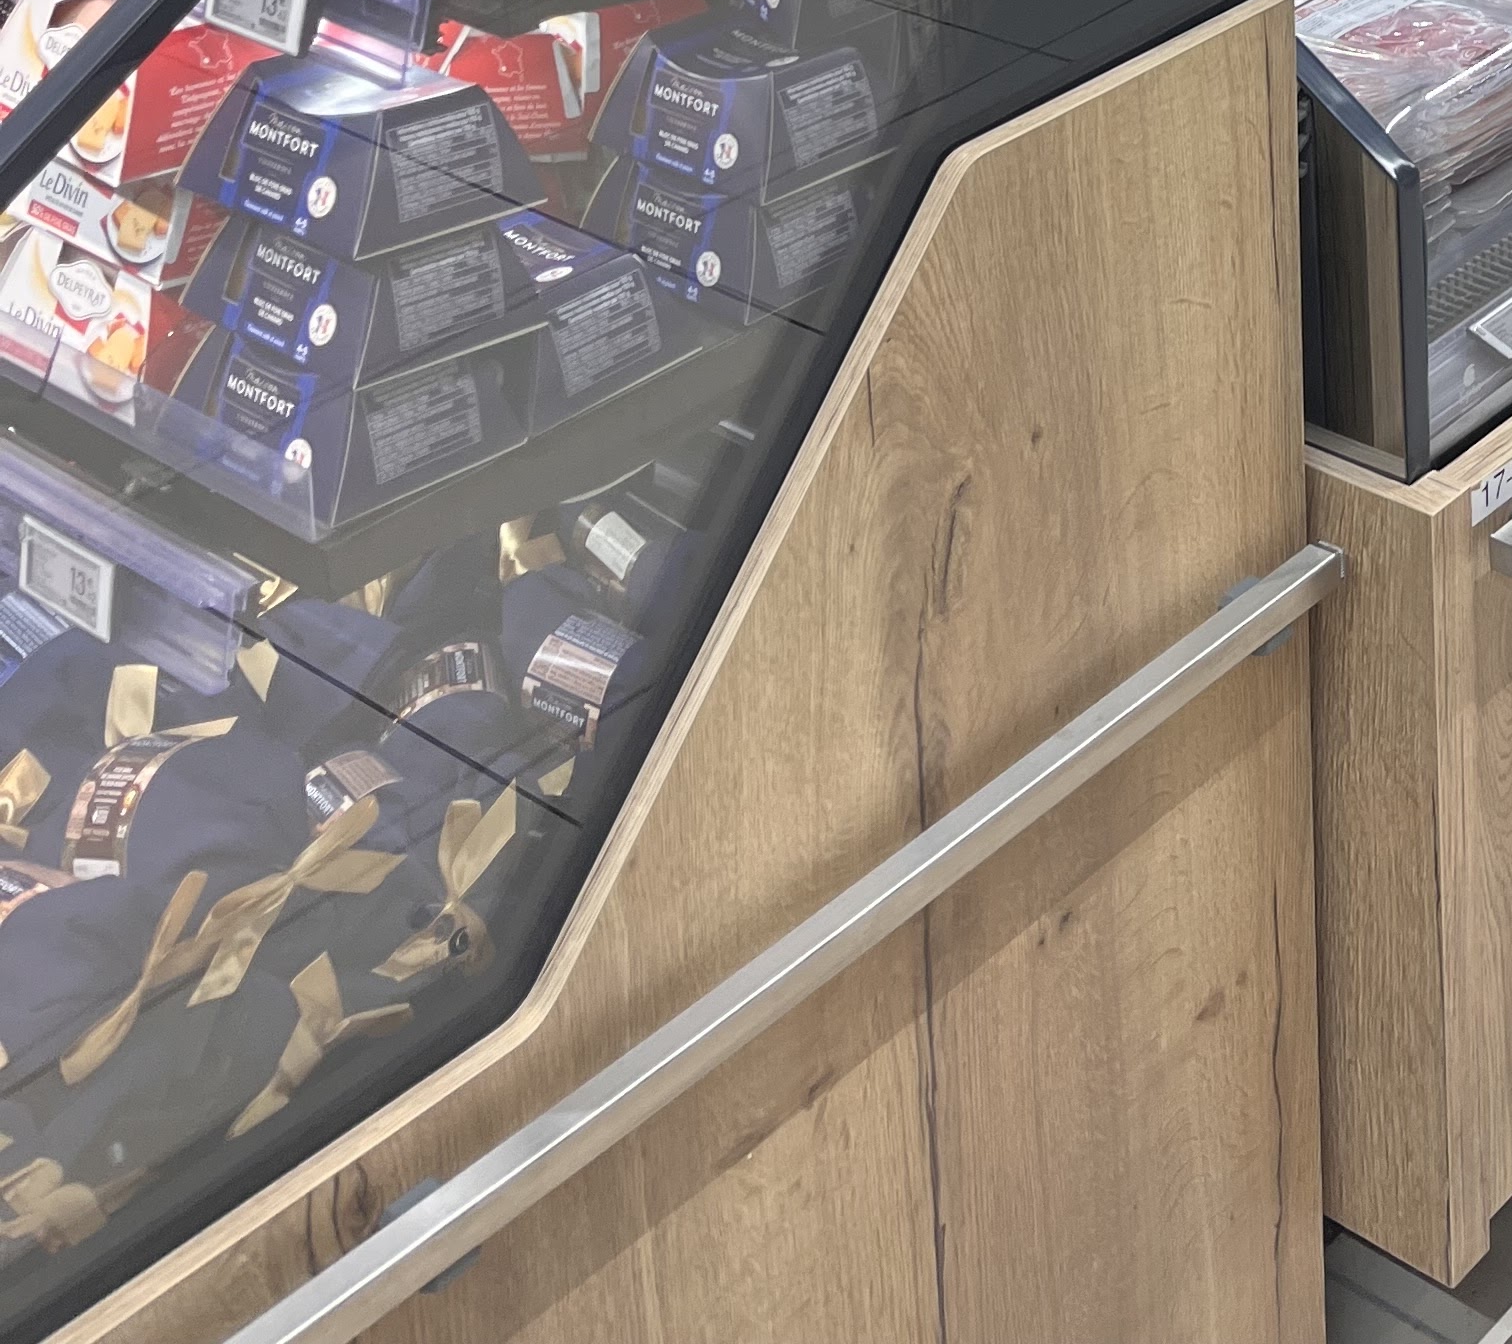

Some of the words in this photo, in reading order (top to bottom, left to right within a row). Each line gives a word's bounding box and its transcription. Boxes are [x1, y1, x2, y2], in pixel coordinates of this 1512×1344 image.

[12, 68, 33, 95] Div
[653, 83, 720, 118] MONTFORT
[249, 120, 320, 159] MONTFORT
[53, 173, 89, 210] Divin
[636, 198, 703, 235] MONTFORT
[502, 227, 576, 264] MONTFORT
[256, 243, 322, 286] MONTFORT
[57, 271, 107, 307] DELPEYRAT
[227, 374, 295, 419] MONTFORT
[532, 698, 585, 729] MONTFORT
